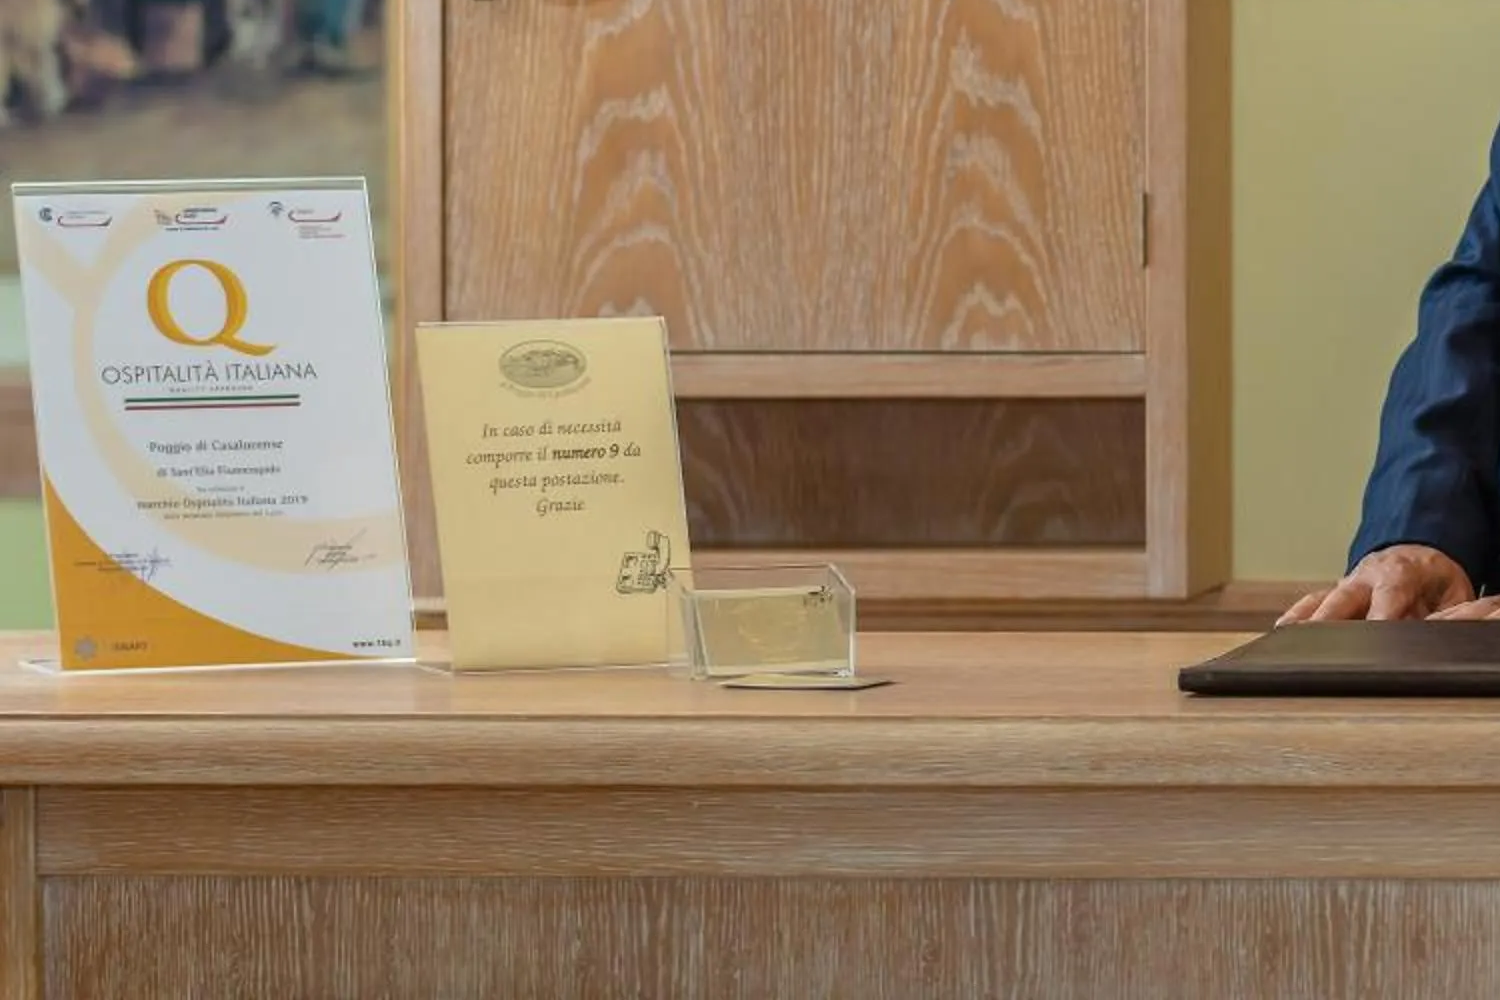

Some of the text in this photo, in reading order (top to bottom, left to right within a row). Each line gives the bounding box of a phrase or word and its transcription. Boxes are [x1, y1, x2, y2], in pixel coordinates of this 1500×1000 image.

[147, 259, 276, 357] Q
[101, 360, 318, 385] OSPITALITÀ ITALIANA
[482, 423, 498, 438] In
[503, 425, 534, 437] caso
[539, 422, 553, 435] di
[149, 441, 192, 454] Poggio
[196, 439, 206, 451] di
[466, 441, 641, 468] comporre il numero 9 da
[489, 470, 625, 495] questa postazione.
[536, 498, 585, 517] Grazie
